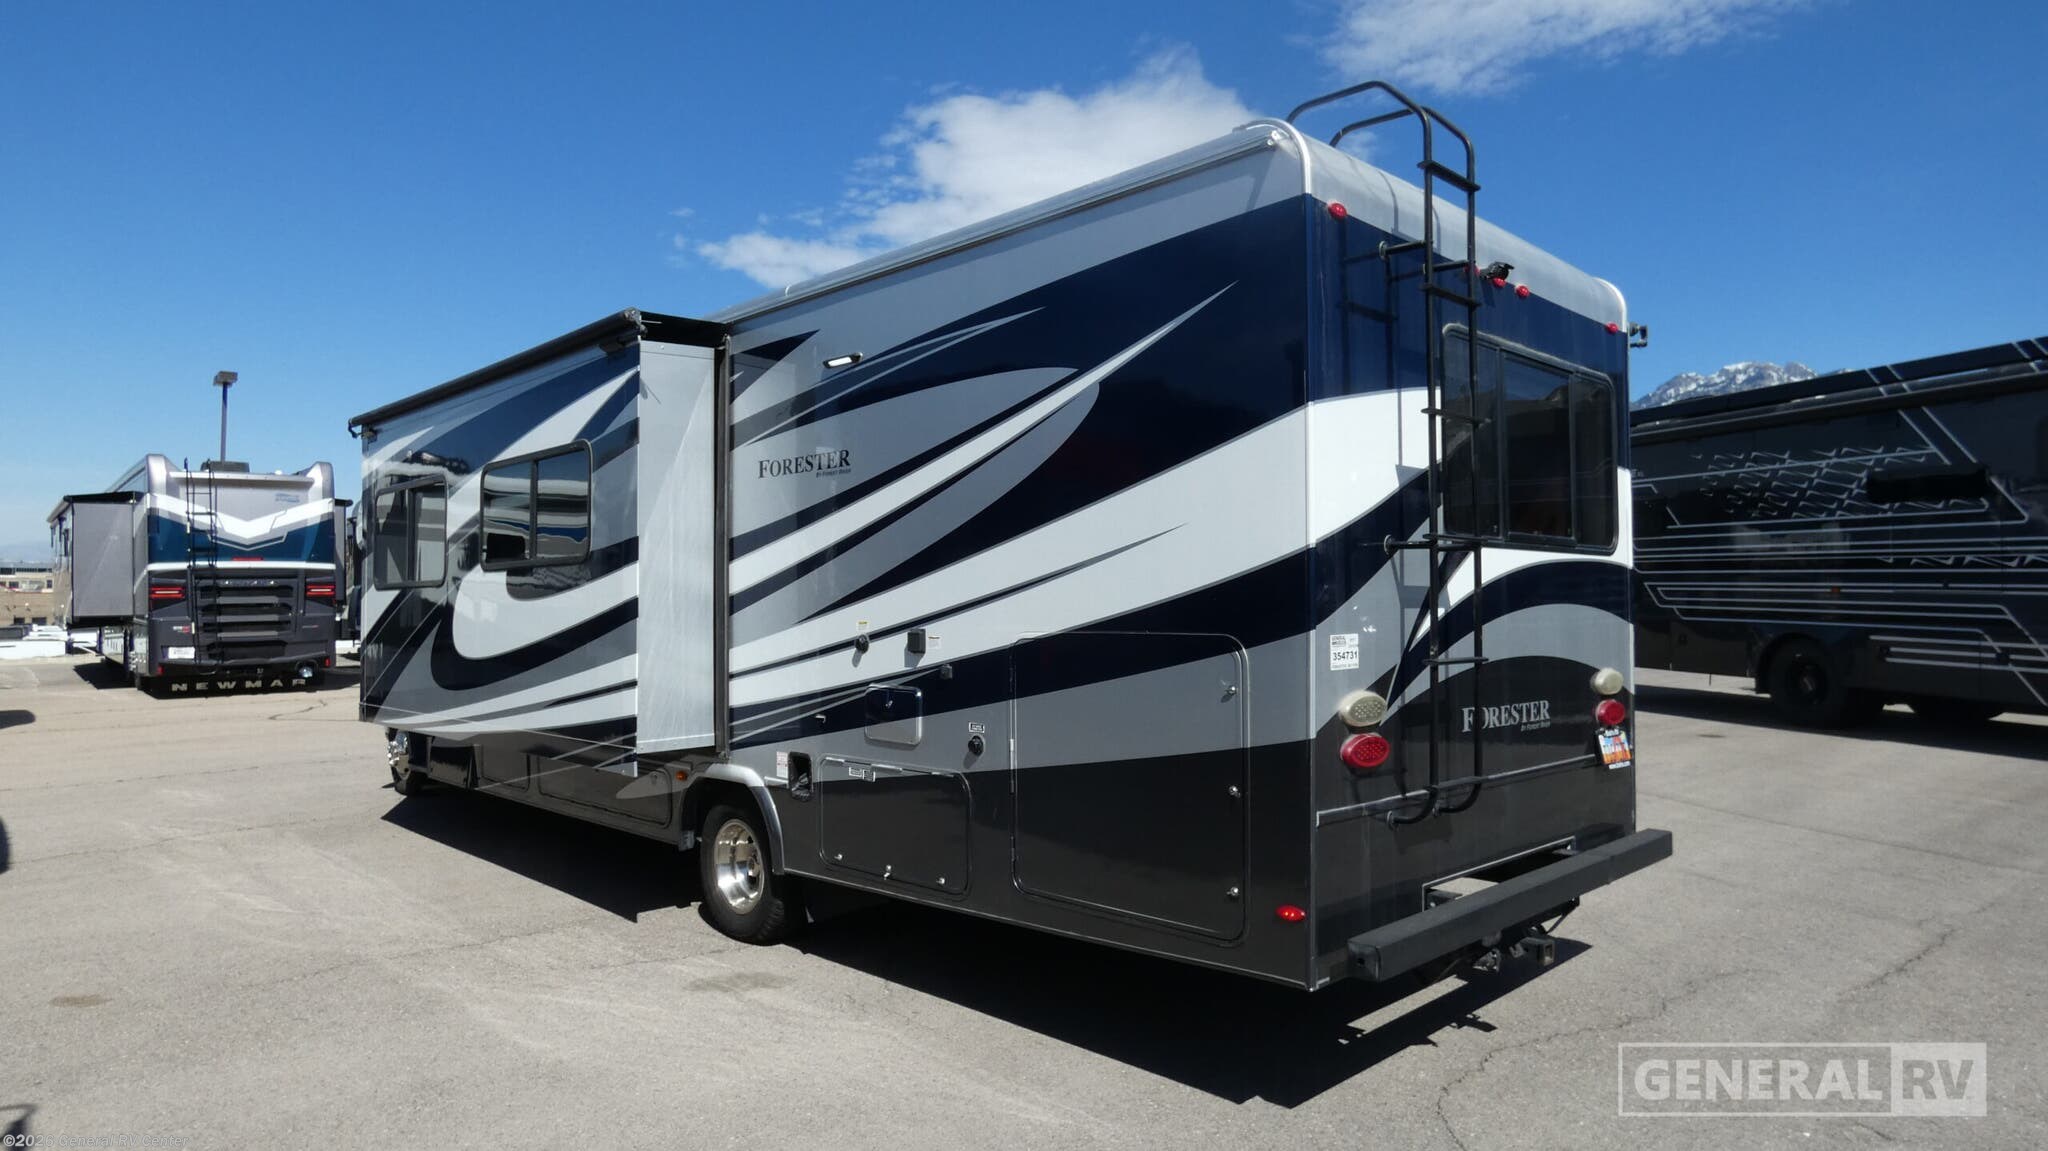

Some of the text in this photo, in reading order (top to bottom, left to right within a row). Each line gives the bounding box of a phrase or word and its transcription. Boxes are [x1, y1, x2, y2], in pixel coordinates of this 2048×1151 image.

[758, 449, 851, 479] FORESTER
[1332, 651, 1358, 661] 354731
[171, 678, 306, 692] NEWMAR
